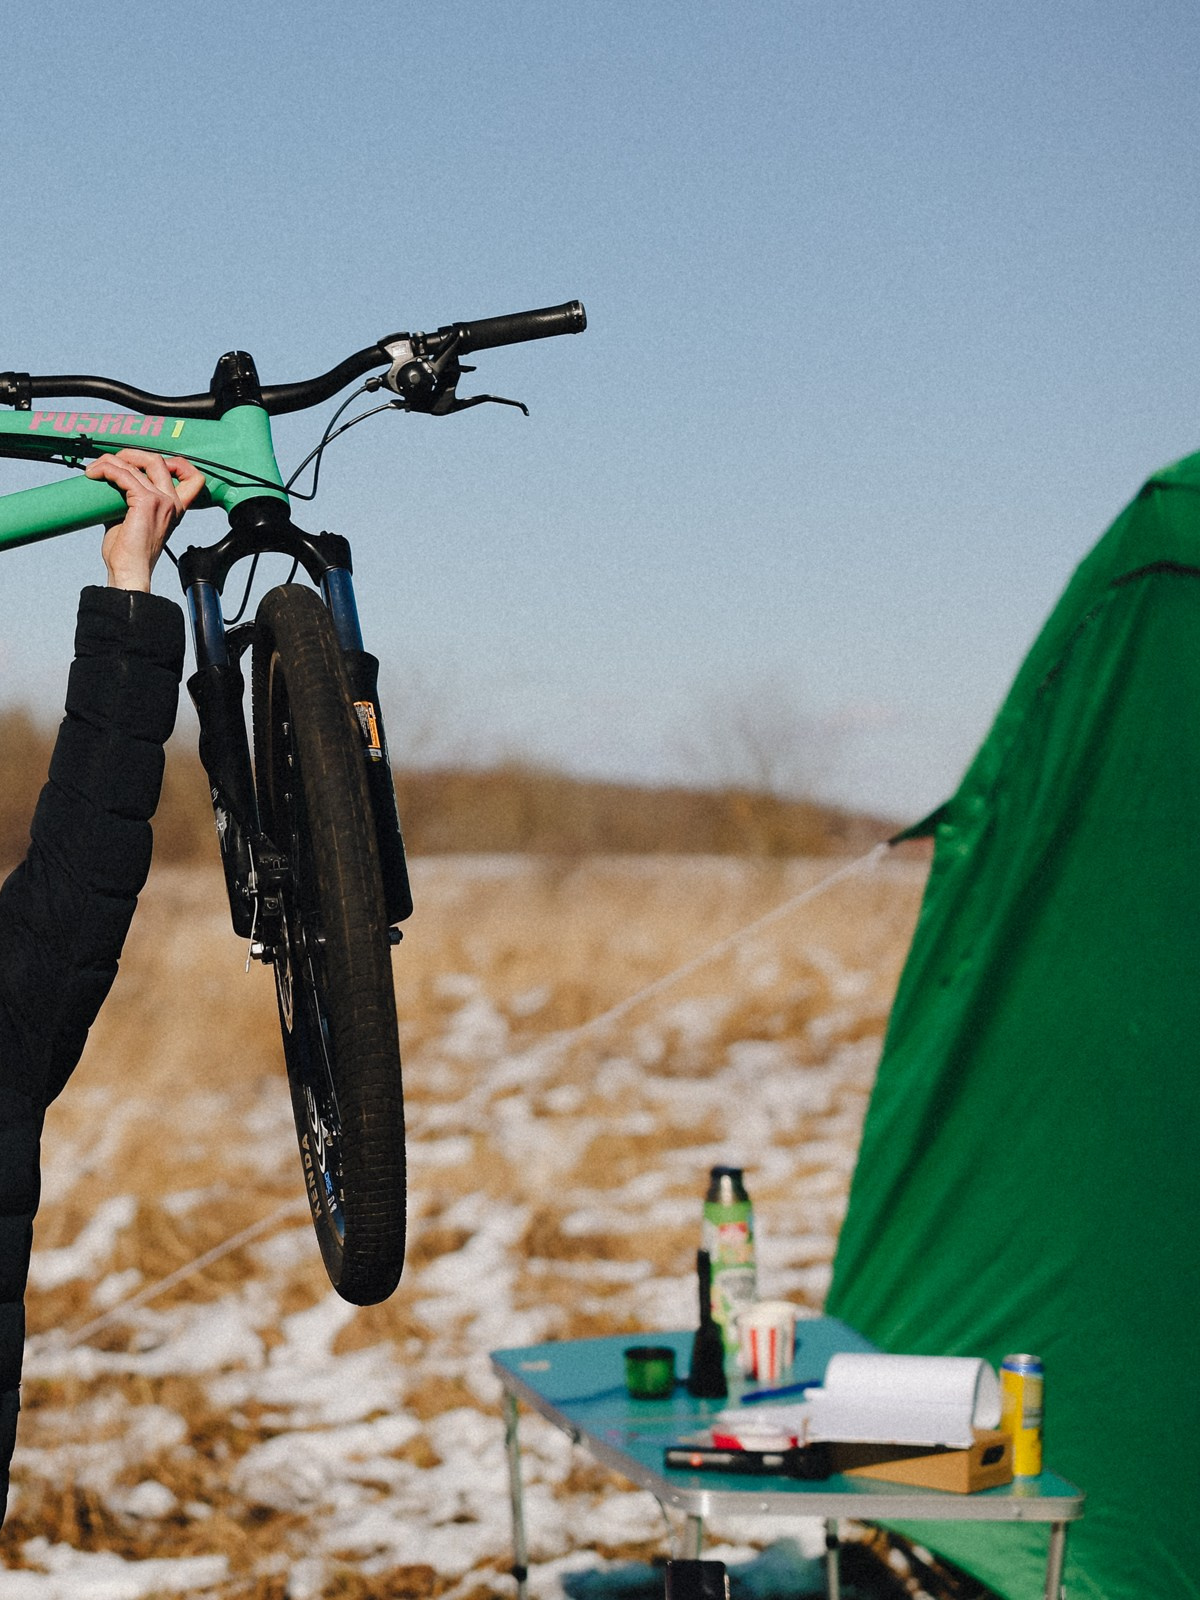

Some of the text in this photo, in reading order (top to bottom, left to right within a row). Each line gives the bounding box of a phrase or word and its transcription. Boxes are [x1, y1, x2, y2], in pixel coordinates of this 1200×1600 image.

[28, 411, 186, 438] PUSHER 1
[301, 1133, 322, 1218] KENDA
